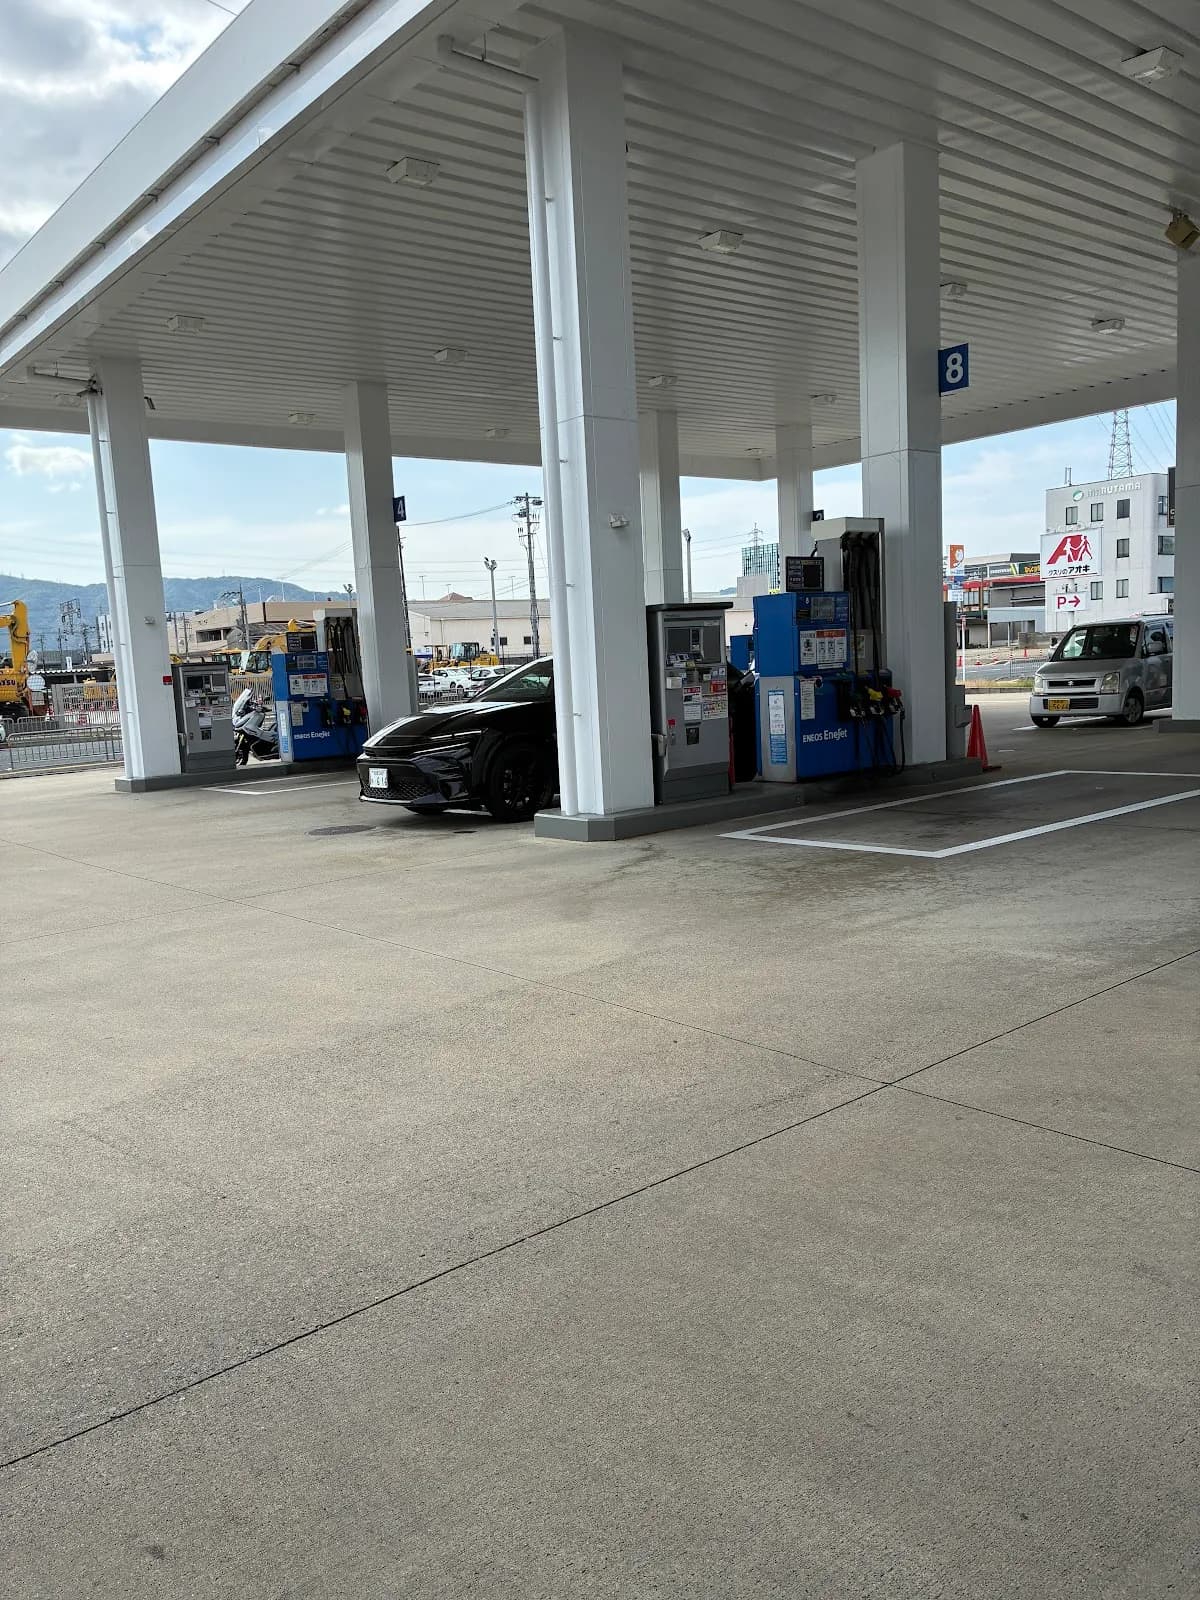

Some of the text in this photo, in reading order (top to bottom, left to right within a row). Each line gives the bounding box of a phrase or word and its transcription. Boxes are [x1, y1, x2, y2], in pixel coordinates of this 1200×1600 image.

[946, 352, 963, 384] 8
[398, 499, 404, 518] 4
[1048, 564, 1091, 576] クスリのアオキ
[1057, 596, 1067, 609] P
[803, 733, 823, 743] ENEOS
